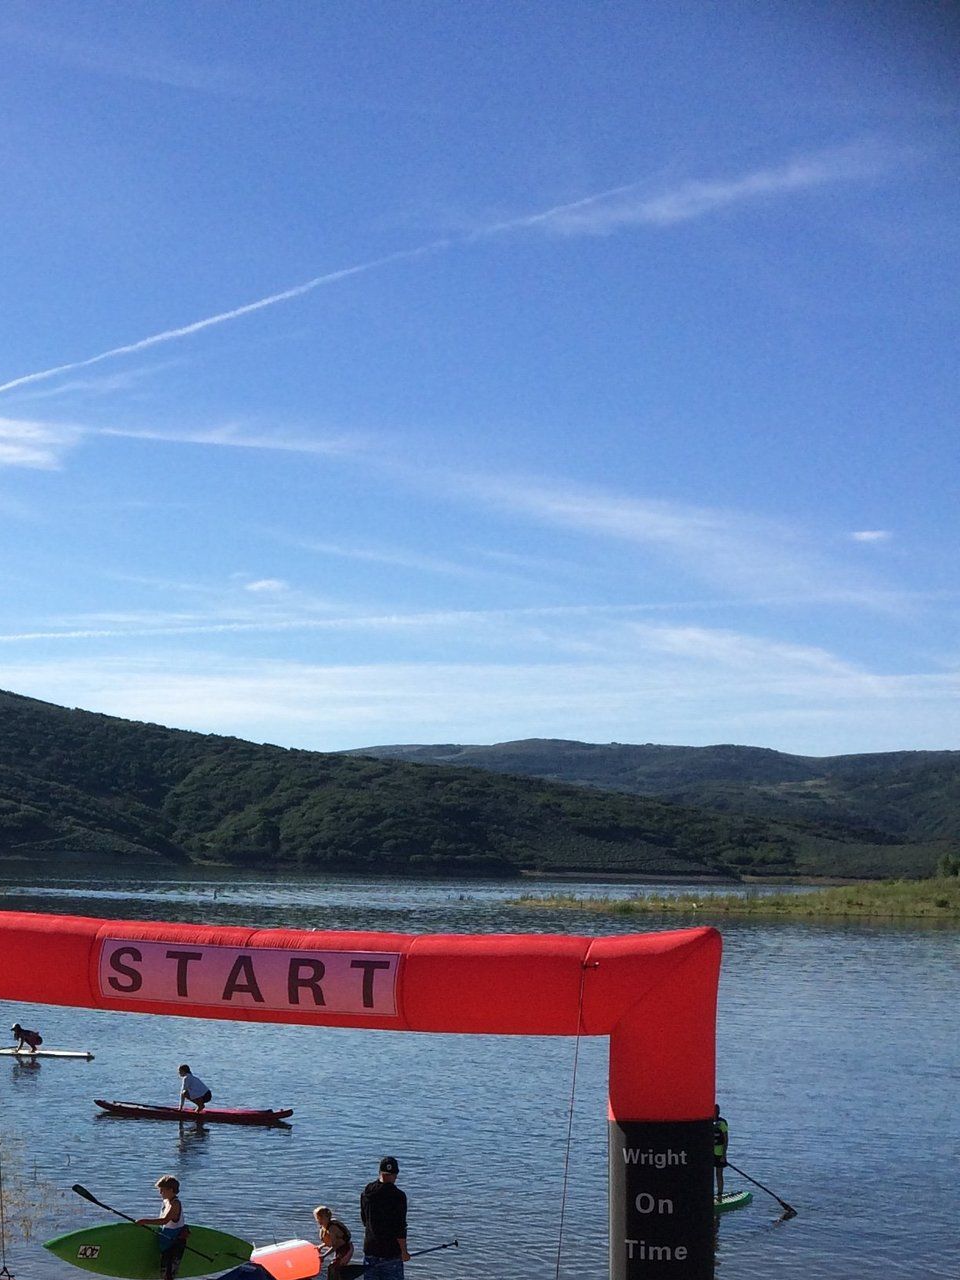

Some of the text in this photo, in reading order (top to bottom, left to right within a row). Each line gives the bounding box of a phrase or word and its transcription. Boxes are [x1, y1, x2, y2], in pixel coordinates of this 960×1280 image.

[107, 946, 391, 1008] START
[622, 1147, 688, 1169] Wright
[635, 1192, 674, 1214] On
[624, 1239, 688, 1261] Time
